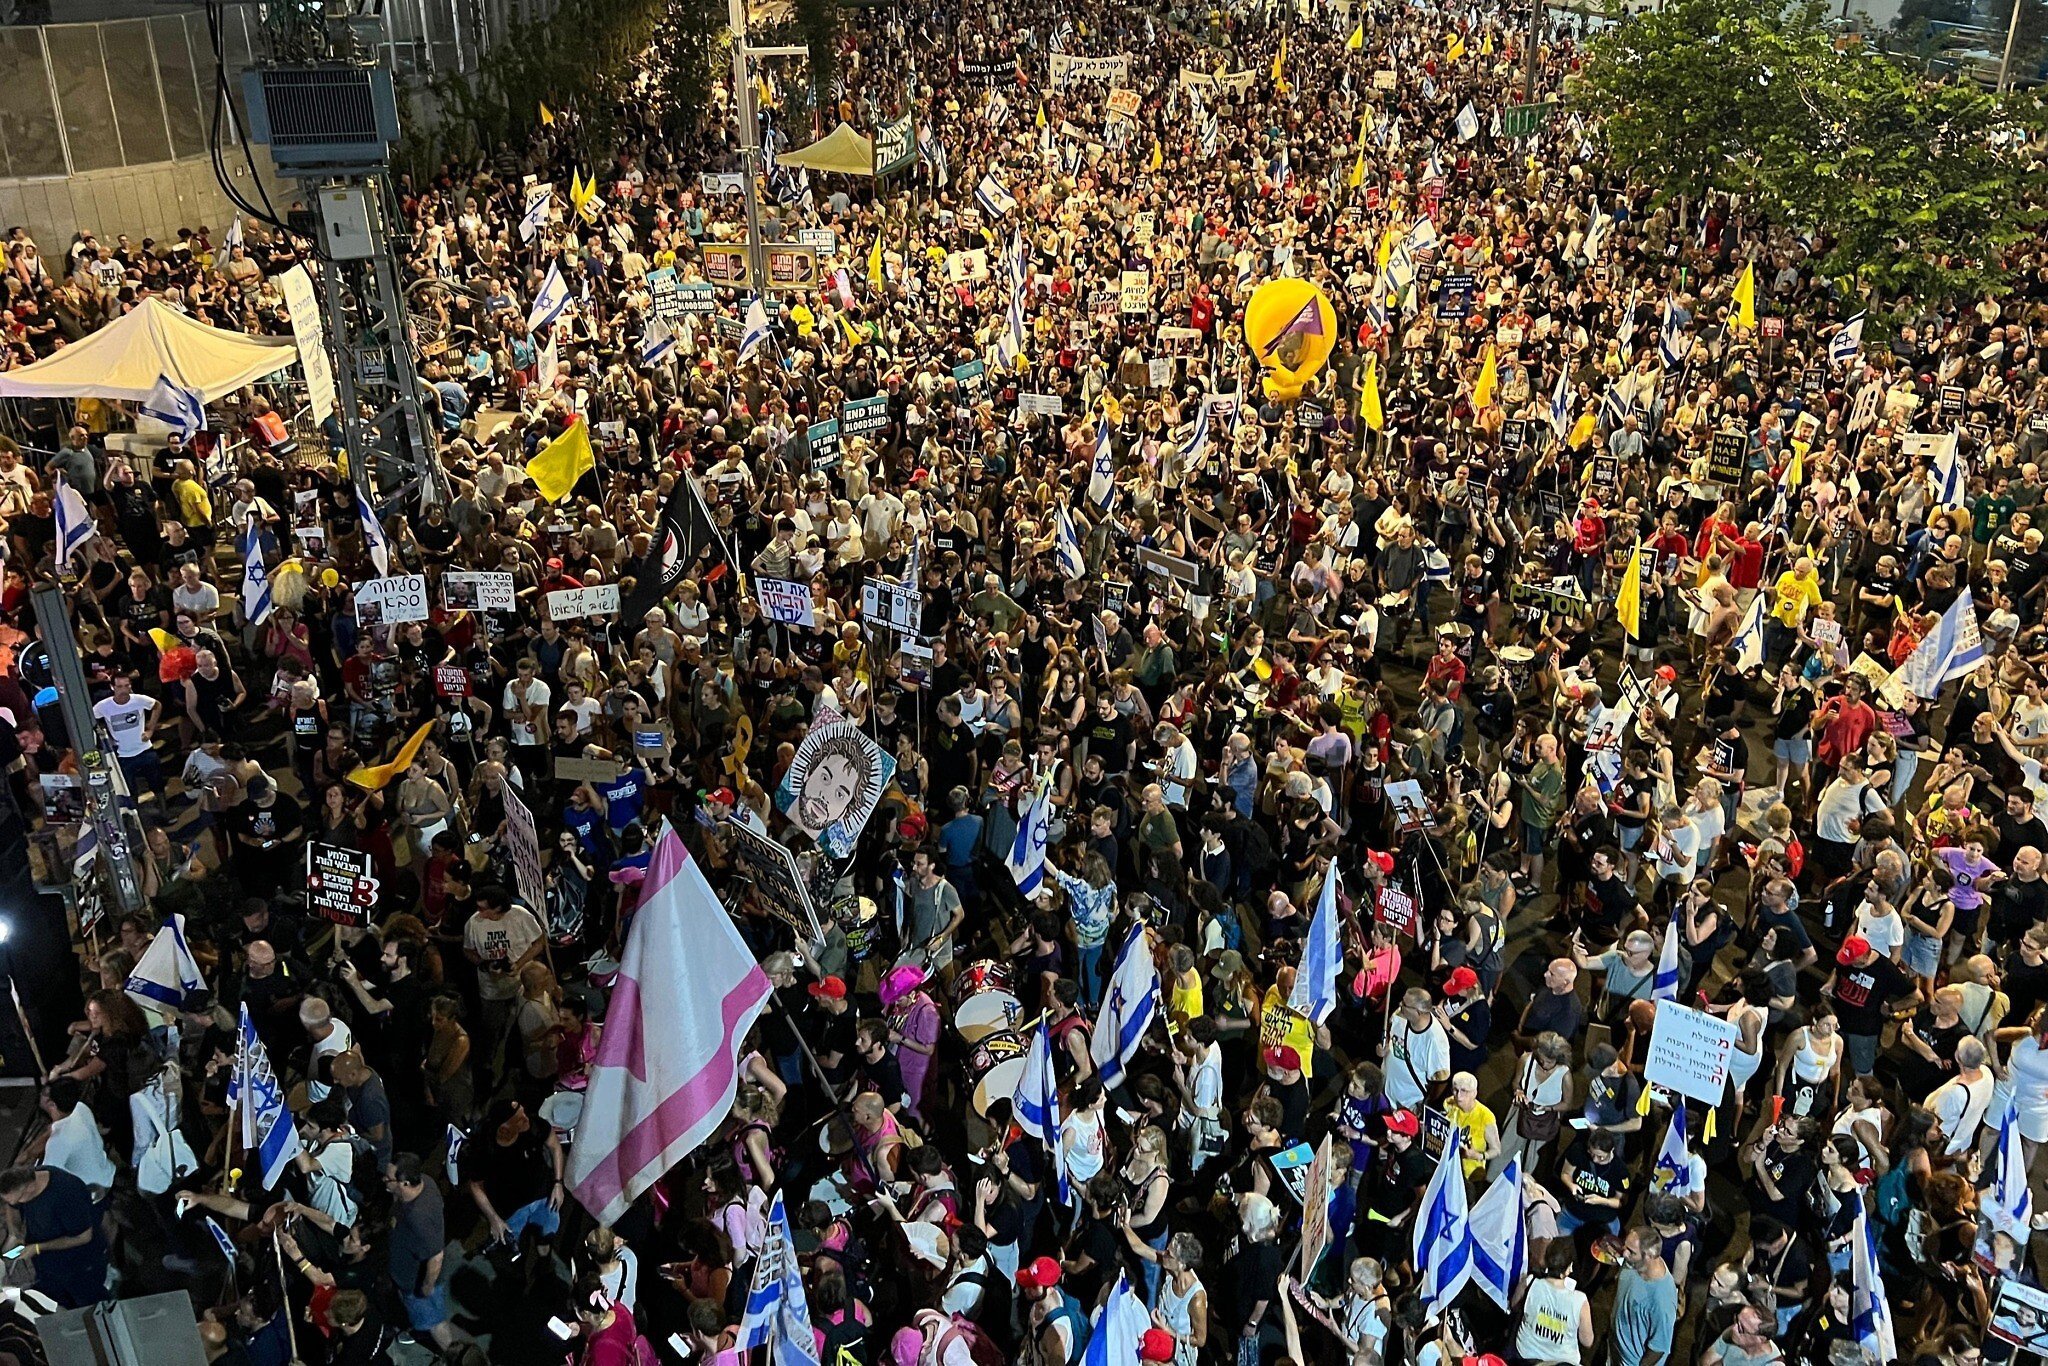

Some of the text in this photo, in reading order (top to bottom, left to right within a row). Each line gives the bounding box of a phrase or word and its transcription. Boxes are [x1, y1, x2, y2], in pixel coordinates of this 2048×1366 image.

[1086, 61, 1096, 70] לא
[1100, 60, 1124, 69] לעולם
[677, 290, 713, 300] END THE
[677, 301, 715, 311] BLOODSHED
[846, 403, 886, 421] END THE
[845, 416, 887, 432] BLOODSHED
[821, 433, 837, 445] כמה
[1716, 436, 1740, 446] WAR
[819, 445, 832, 457] עוד
[1715, 446, 1737, 457] HAS
[1714, 456, 1729, 465] NO
[1711, 465, 1742, 477] WINNERS
[369, 577, 421, 594] סליחה
[790, 584, 807, 598] את
[385, 594, 420, 609] סבא
[483, 596, 510, 605] עסקה
[589, 598, 615, 610] לשוב
[762, 591, 804, 610] הביתה
[773, 606, 802, 622] עכשיו
[437, 668, 463, 677] ממשלת
[437, 676, 467, 684] ההפקרה
[443, 683, 465, 692] הביתה
[327, 850, 349, 863] הלחץ
[334, 859, 361, 873] הצבאי
[326, 890, 349, 903] הלחץ
[1382, 887, 1412, 906] ממשלת
[334, 900, 361, 914] הצבאי
[1379, 895, 1413, 918] ההפקרה
[1383, 908, 1407, 926] הביתה
[487, 930, 507, 941] אתה
[485, 939, 510, 950] הראש
[1265, 1012, 1293, 1033] הראש
[1691, 1031, 1729, 1050] ממשלת
[1693, 1070, 1722, 1085] חורבן
[1536, 1323, 1564, 1345] NOW!
